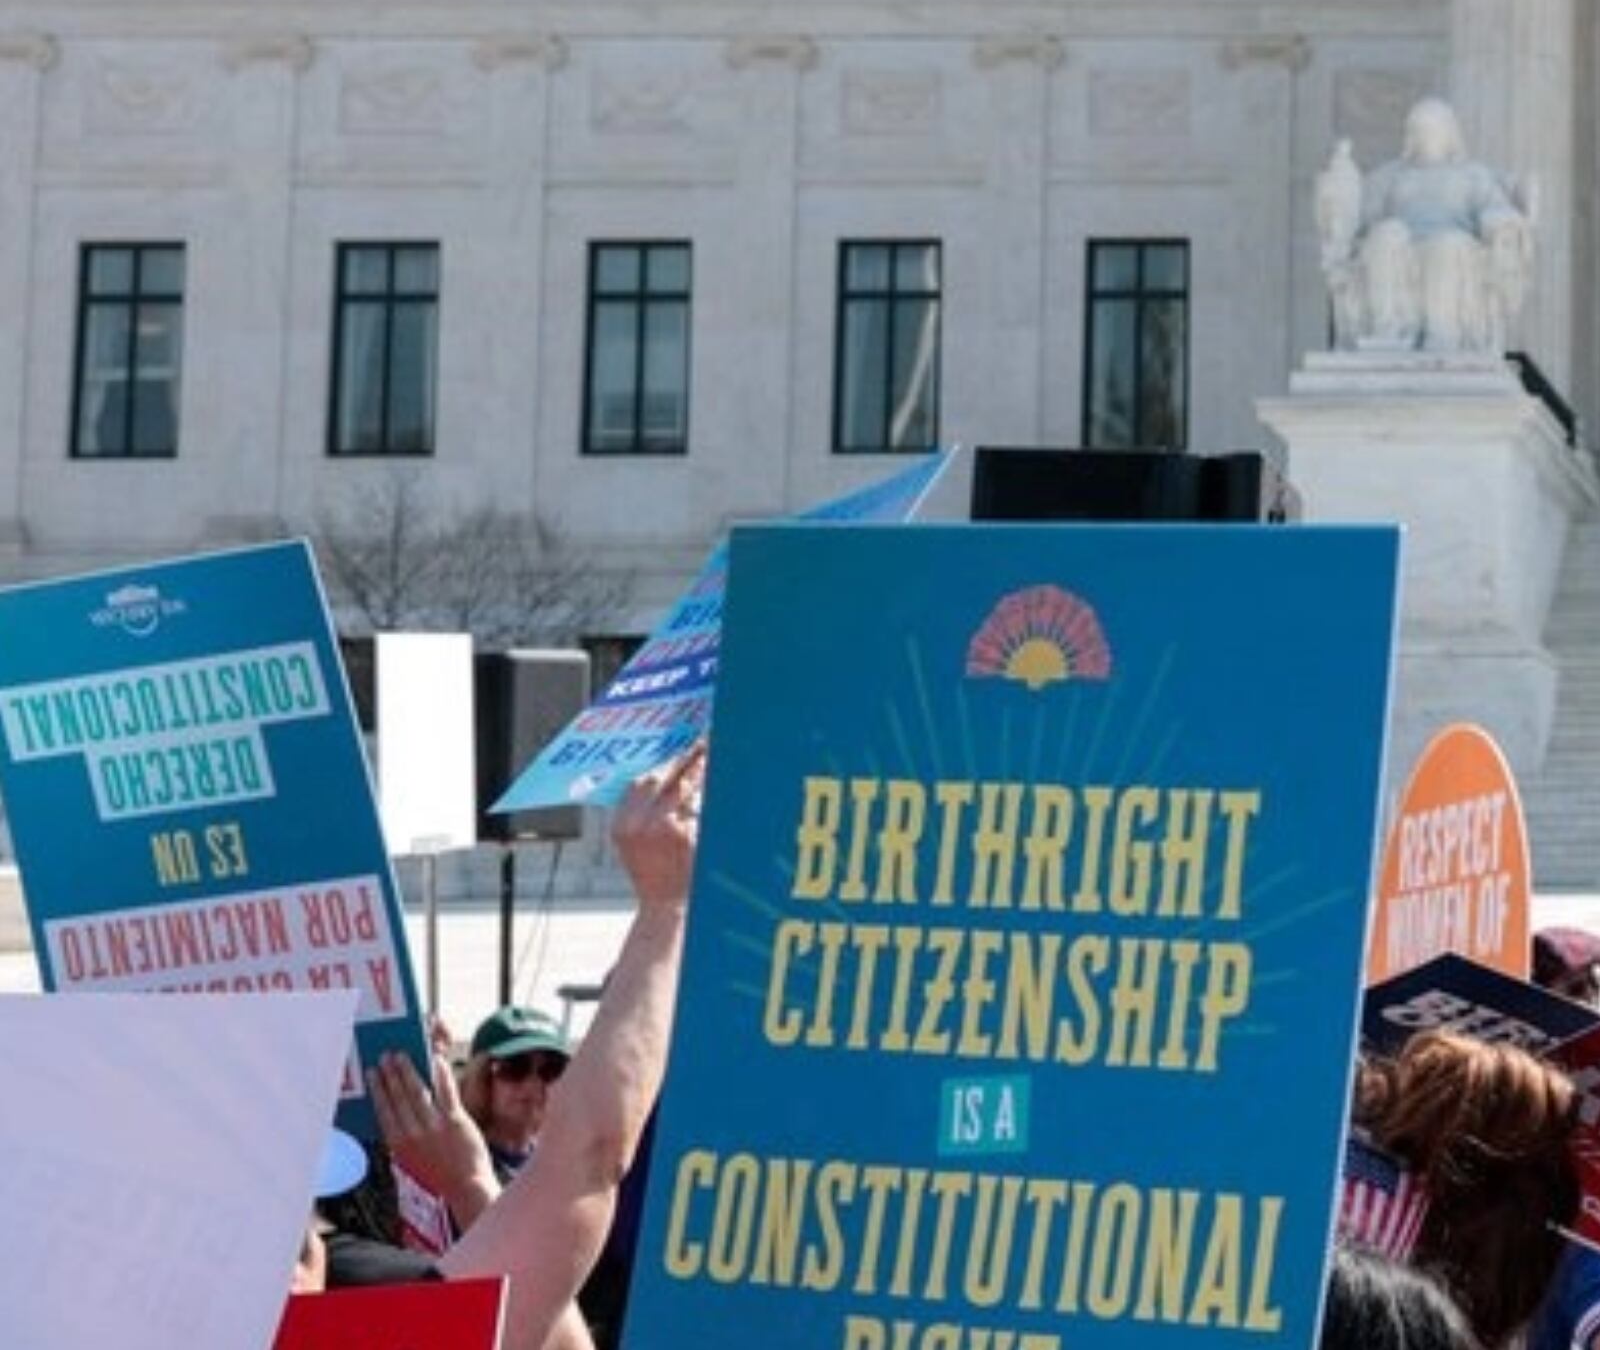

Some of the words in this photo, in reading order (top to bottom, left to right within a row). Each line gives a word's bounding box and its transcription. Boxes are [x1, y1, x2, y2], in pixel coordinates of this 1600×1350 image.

[9, 656, 317, 751] CONSTITUCIONAL
[102, 735, 262, 810] DERECHO
[150, 831, 200, 886] UN
[208, 822, 248, 878] ES
[790, 776, 1262, 921] BIRTHRIGHT
[1400, 791, 1504, 891] RESPECT
[60, 900, 291, 983] NACIMIENTO
[297, 885, 378, 949] POR
[1476, 872, 1510, 956] OF
[763, 920, 1253, 1073] CITIZENSHIP
[952, 1087, 984, 1144] IS
[996, 1092, 1016, 1140] A
[664, 1151, 1285, 1332] CONSTITUTIONAL
